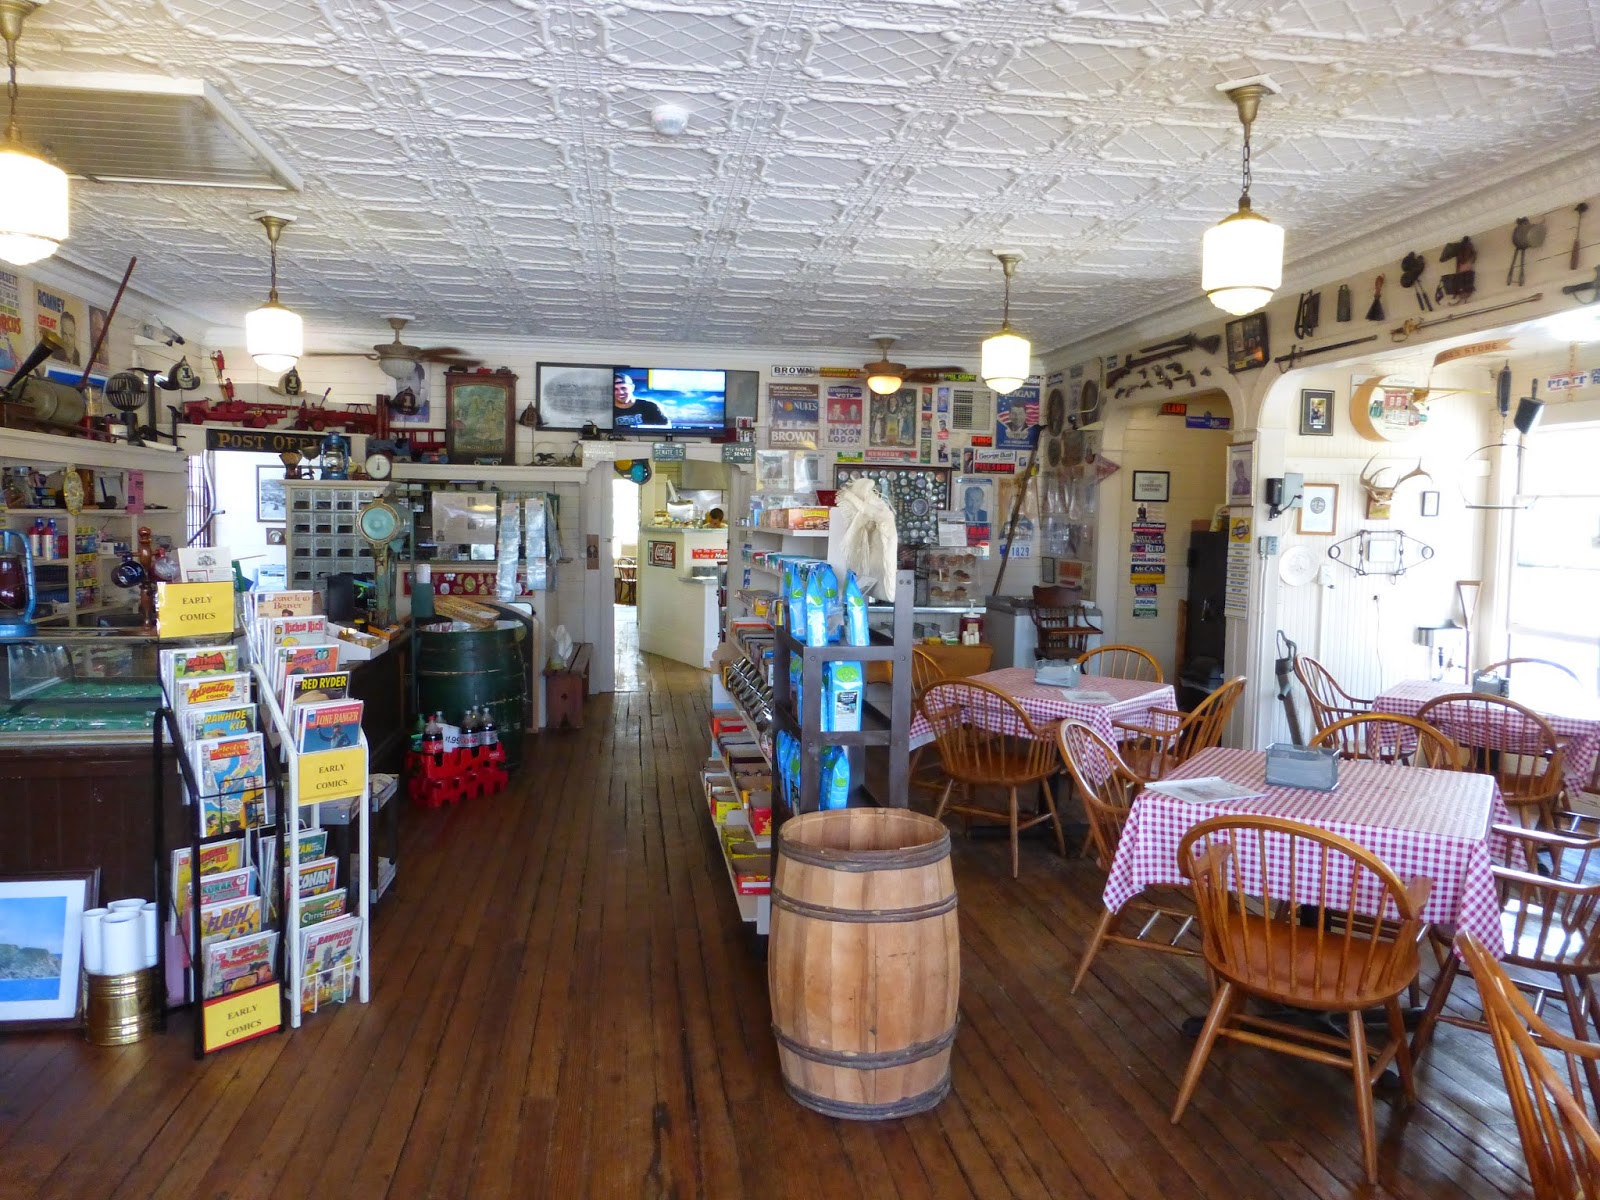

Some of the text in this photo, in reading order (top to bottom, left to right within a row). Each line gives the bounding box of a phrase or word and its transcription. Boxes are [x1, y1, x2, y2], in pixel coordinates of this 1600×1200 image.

[38, 289, 65, 313] ROMNEY
[774, 366, 813, 375] BROWN
[771, 431, 816, 442] BROWN
[829, 428, 862, 436] NIXON
[217, 432, 267, 450] POST
[1011, 546, 1030, 557] 1829
[182, 596, 213, 605] EARLY
[179, 612, 216, 622] COMICS
[285, 620, 324, 636] Richie Rich
[301, 675, 348, 690] RED RYDER
[188, 683, 235, 704] Adventure
[205, 692, 228, 700] COMICS
[204, 709, 247, 723] RAWHIDE
[316, 711, 359, 726] LONE RANGER
[229, 720, 247, 731] KID
[318, 764, 345, 774] EARLY
[316, 778, 348, 790] COMICS
[206, 904, 250, 933] FLASH
[301, 906, 342, 924] Christmas
[316, 927, 355, 946] RAWHIDE
[336, 936, 353, 948] KID
[227, 1004, 259, 1020] EARLY
[225, 1018, 262, 1038] COMICS
